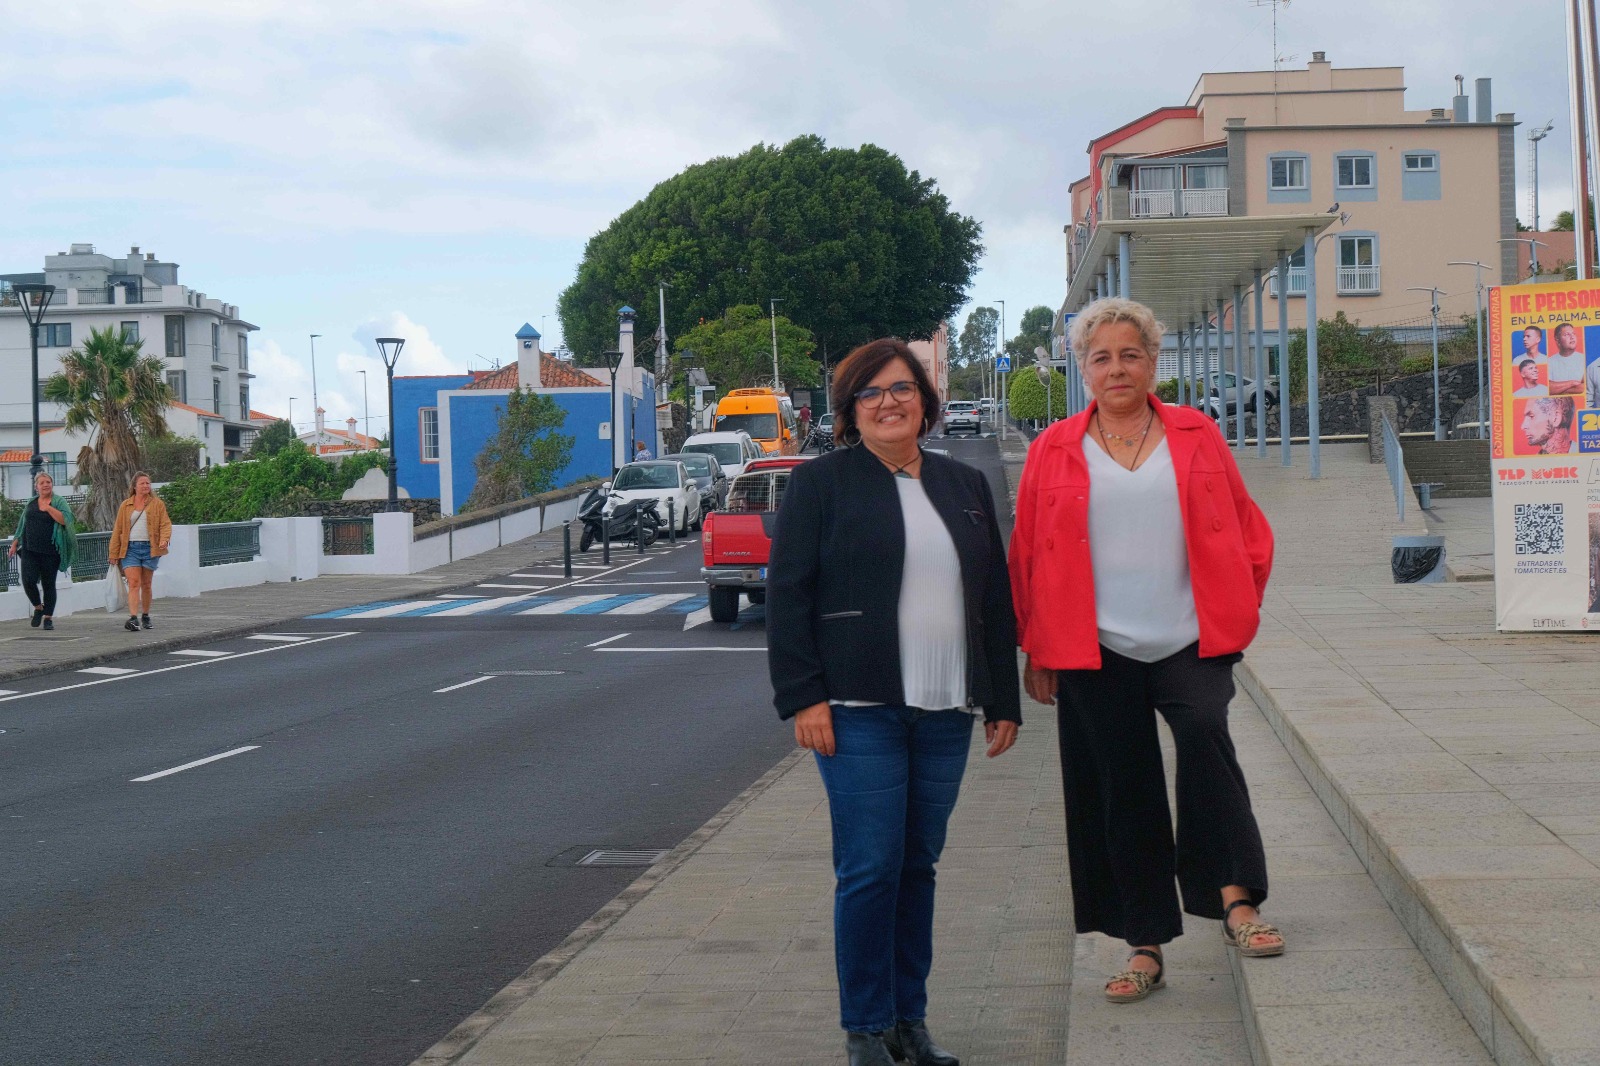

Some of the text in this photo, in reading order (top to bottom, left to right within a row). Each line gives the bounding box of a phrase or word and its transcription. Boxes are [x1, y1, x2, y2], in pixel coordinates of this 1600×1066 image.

[1492, 290, 1500, 341] CANARIAS
[1511, 316, 1526, 325] EN
[1530, 315, 1545, 324] LA
[1549, 312, 1591, 322] PALMA,
[1492, 343, 1501, 358] EN
[1494, 394, 1503, 456] CONCIERTO
